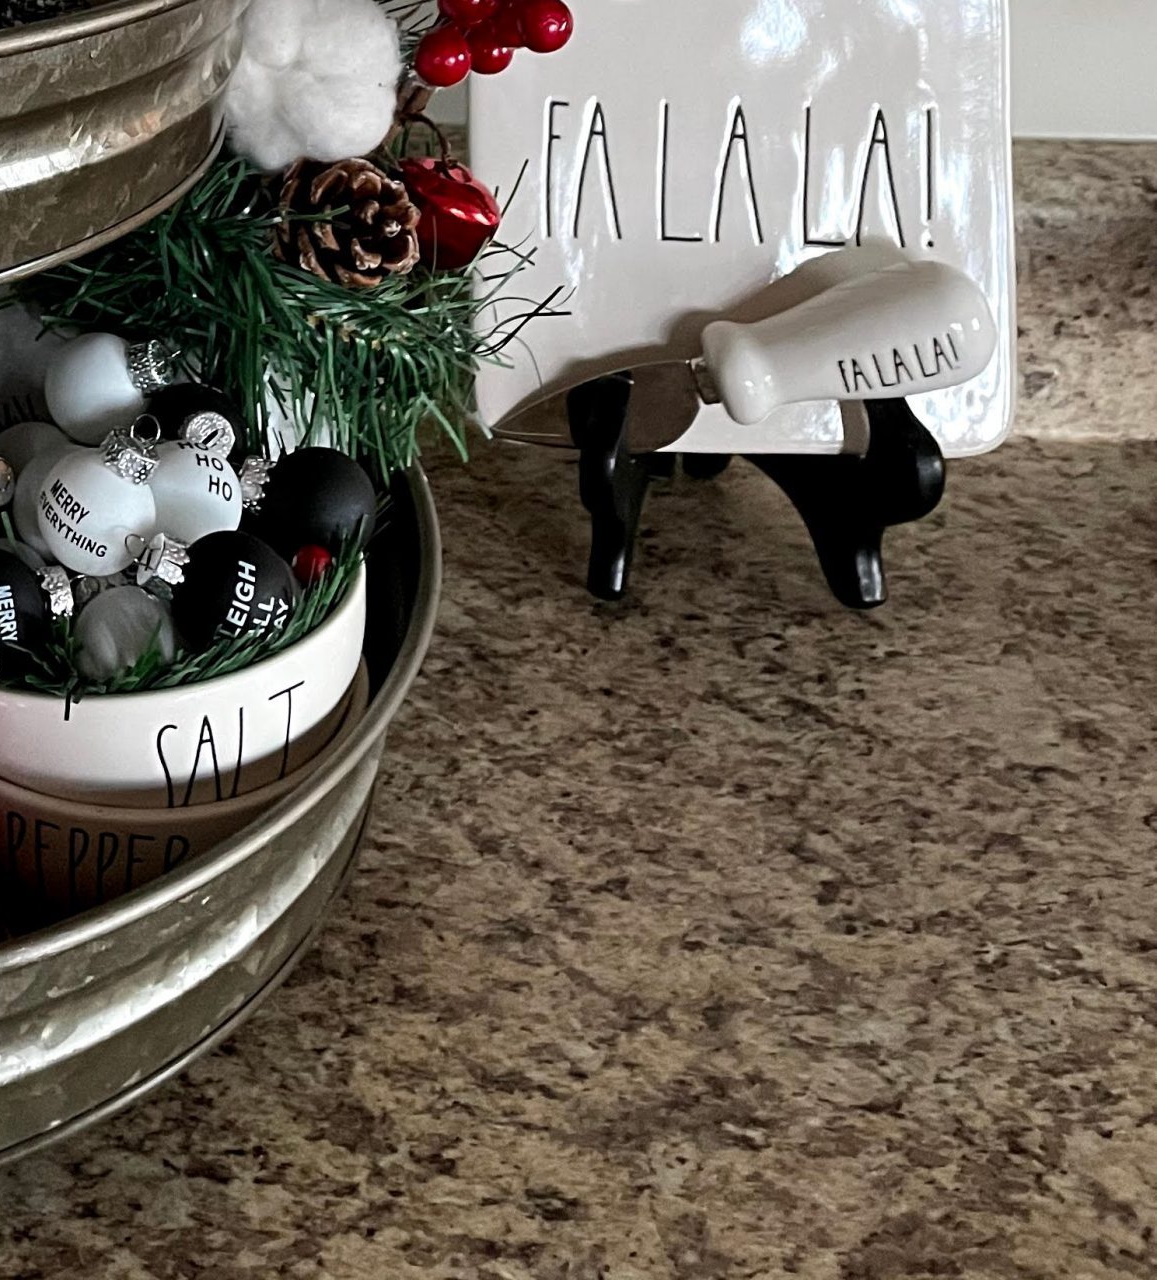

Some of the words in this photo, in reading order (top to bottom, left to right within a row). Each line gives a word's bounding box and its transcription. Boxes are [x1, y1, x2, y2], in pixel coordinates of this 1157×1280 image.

[545, 100, 622, 240] FA
[659, 103, 764, 244] LA
[802, 105, 935, 248] LA!
[837, 357, 873, 394] FA
[871, 347, 914, 388] LA
[195, 452, 224, 472] HO
[207, 474, 233, 502] HO
[39, 489, 108, 558] EVERYTHING
[50, 477, 91, 525] MERRY
[219, 559, 257, 639] LEIGH
[155, 679, 306, 809] SALT
